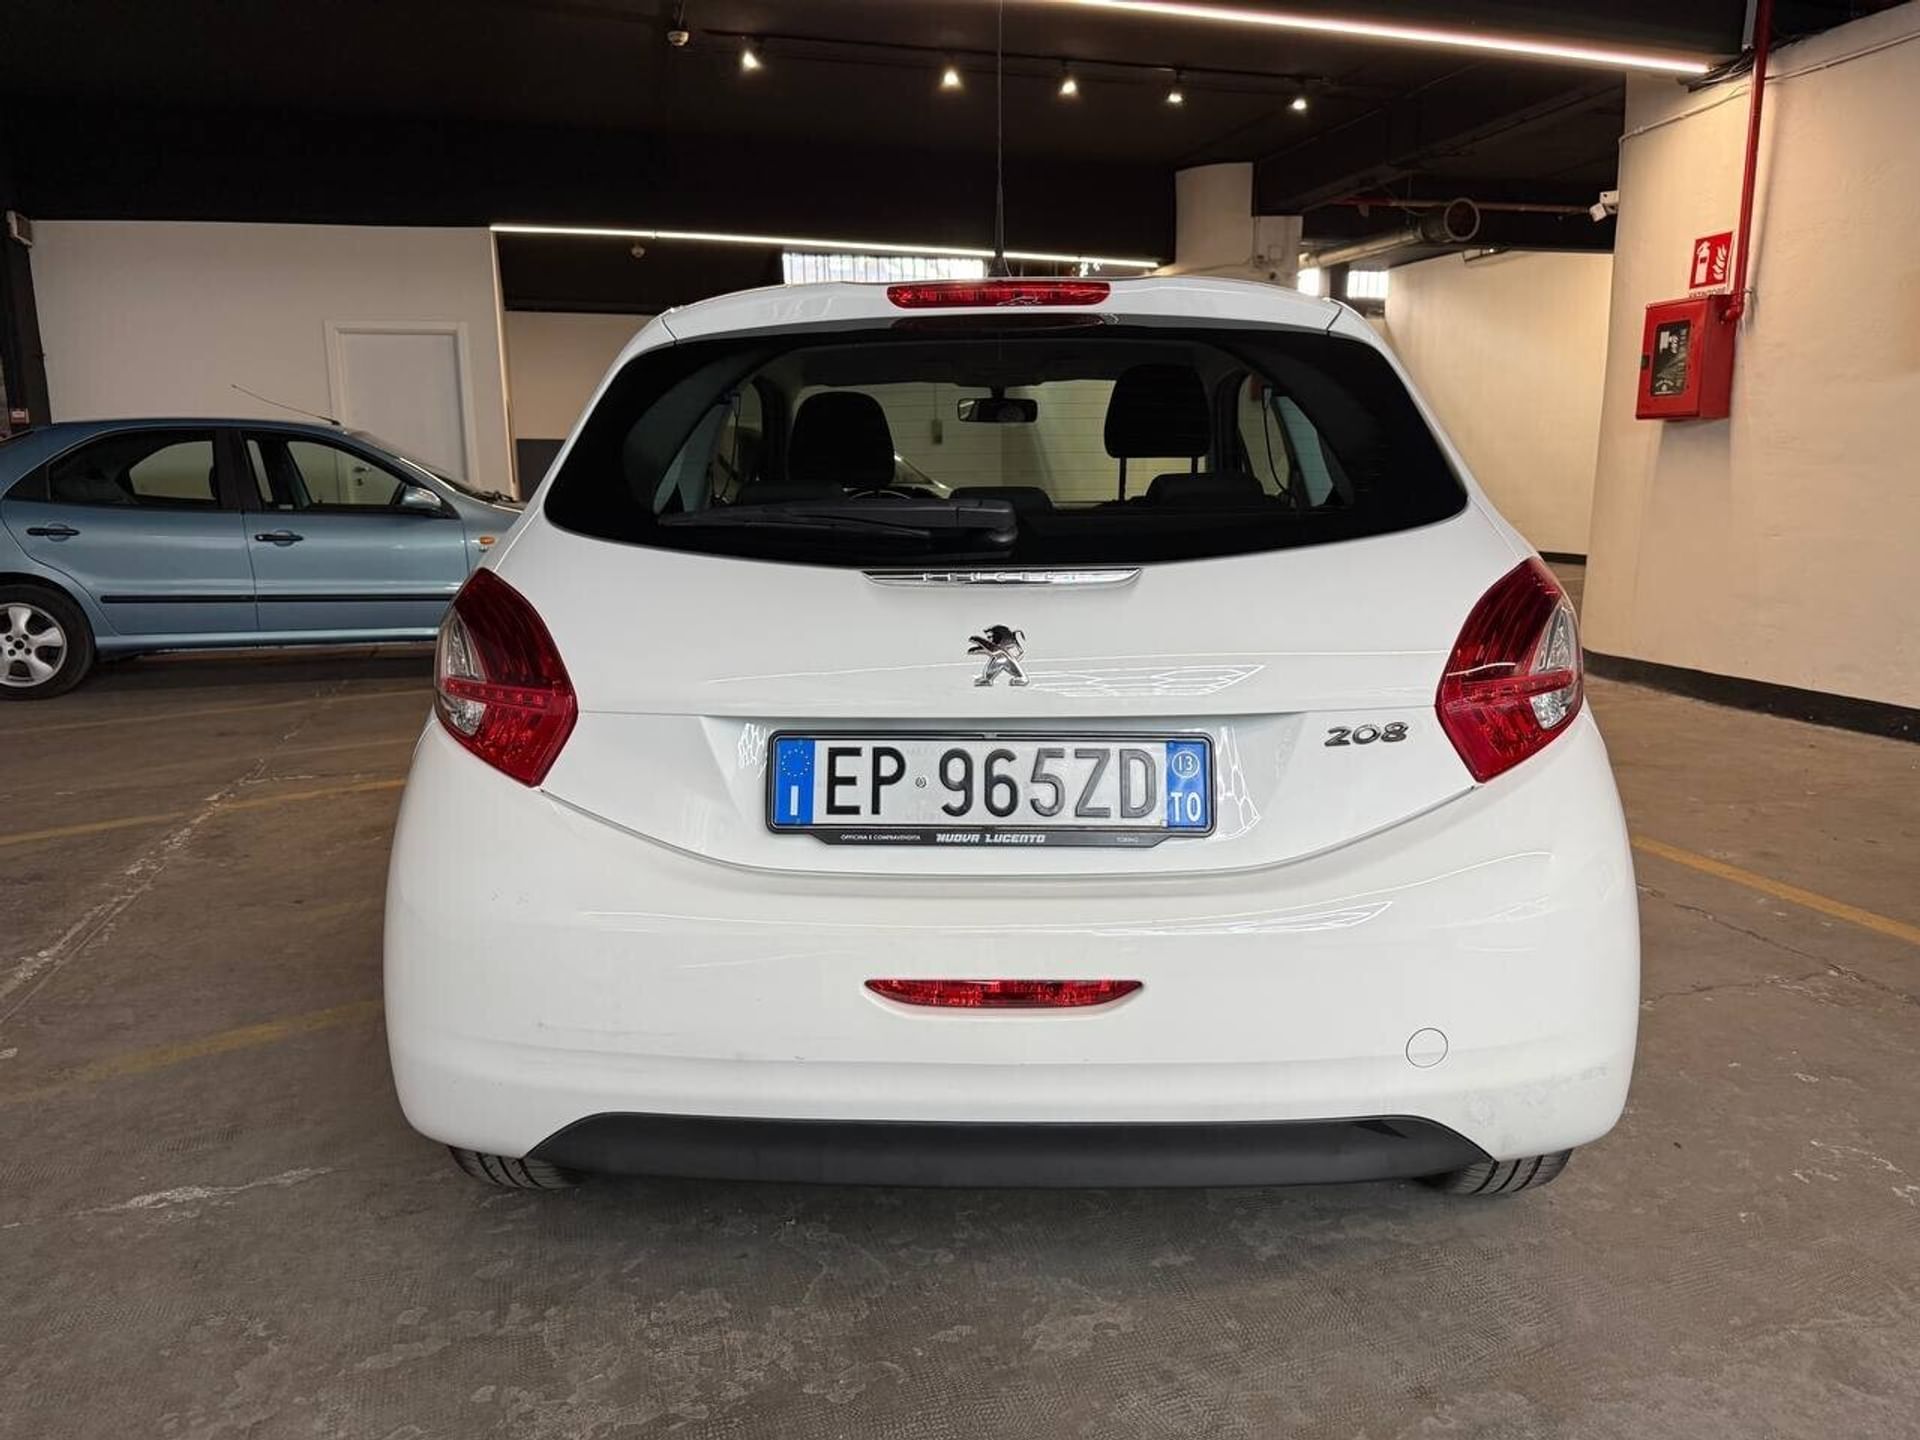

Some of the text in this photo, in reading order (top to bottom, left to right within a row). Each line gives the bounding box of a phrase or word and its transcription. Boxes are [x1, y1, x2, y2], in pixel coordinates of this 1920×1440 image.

[1324, 721, 1408, 747] 208
[1178, 755, 1193, 771] 13
[826, 746, 1157, 818] EP 965ZD
[790, 785, 799, 816] I
[1170, 791, 1202, 822] TO
[936, 833, 980, 843] NUOVA
